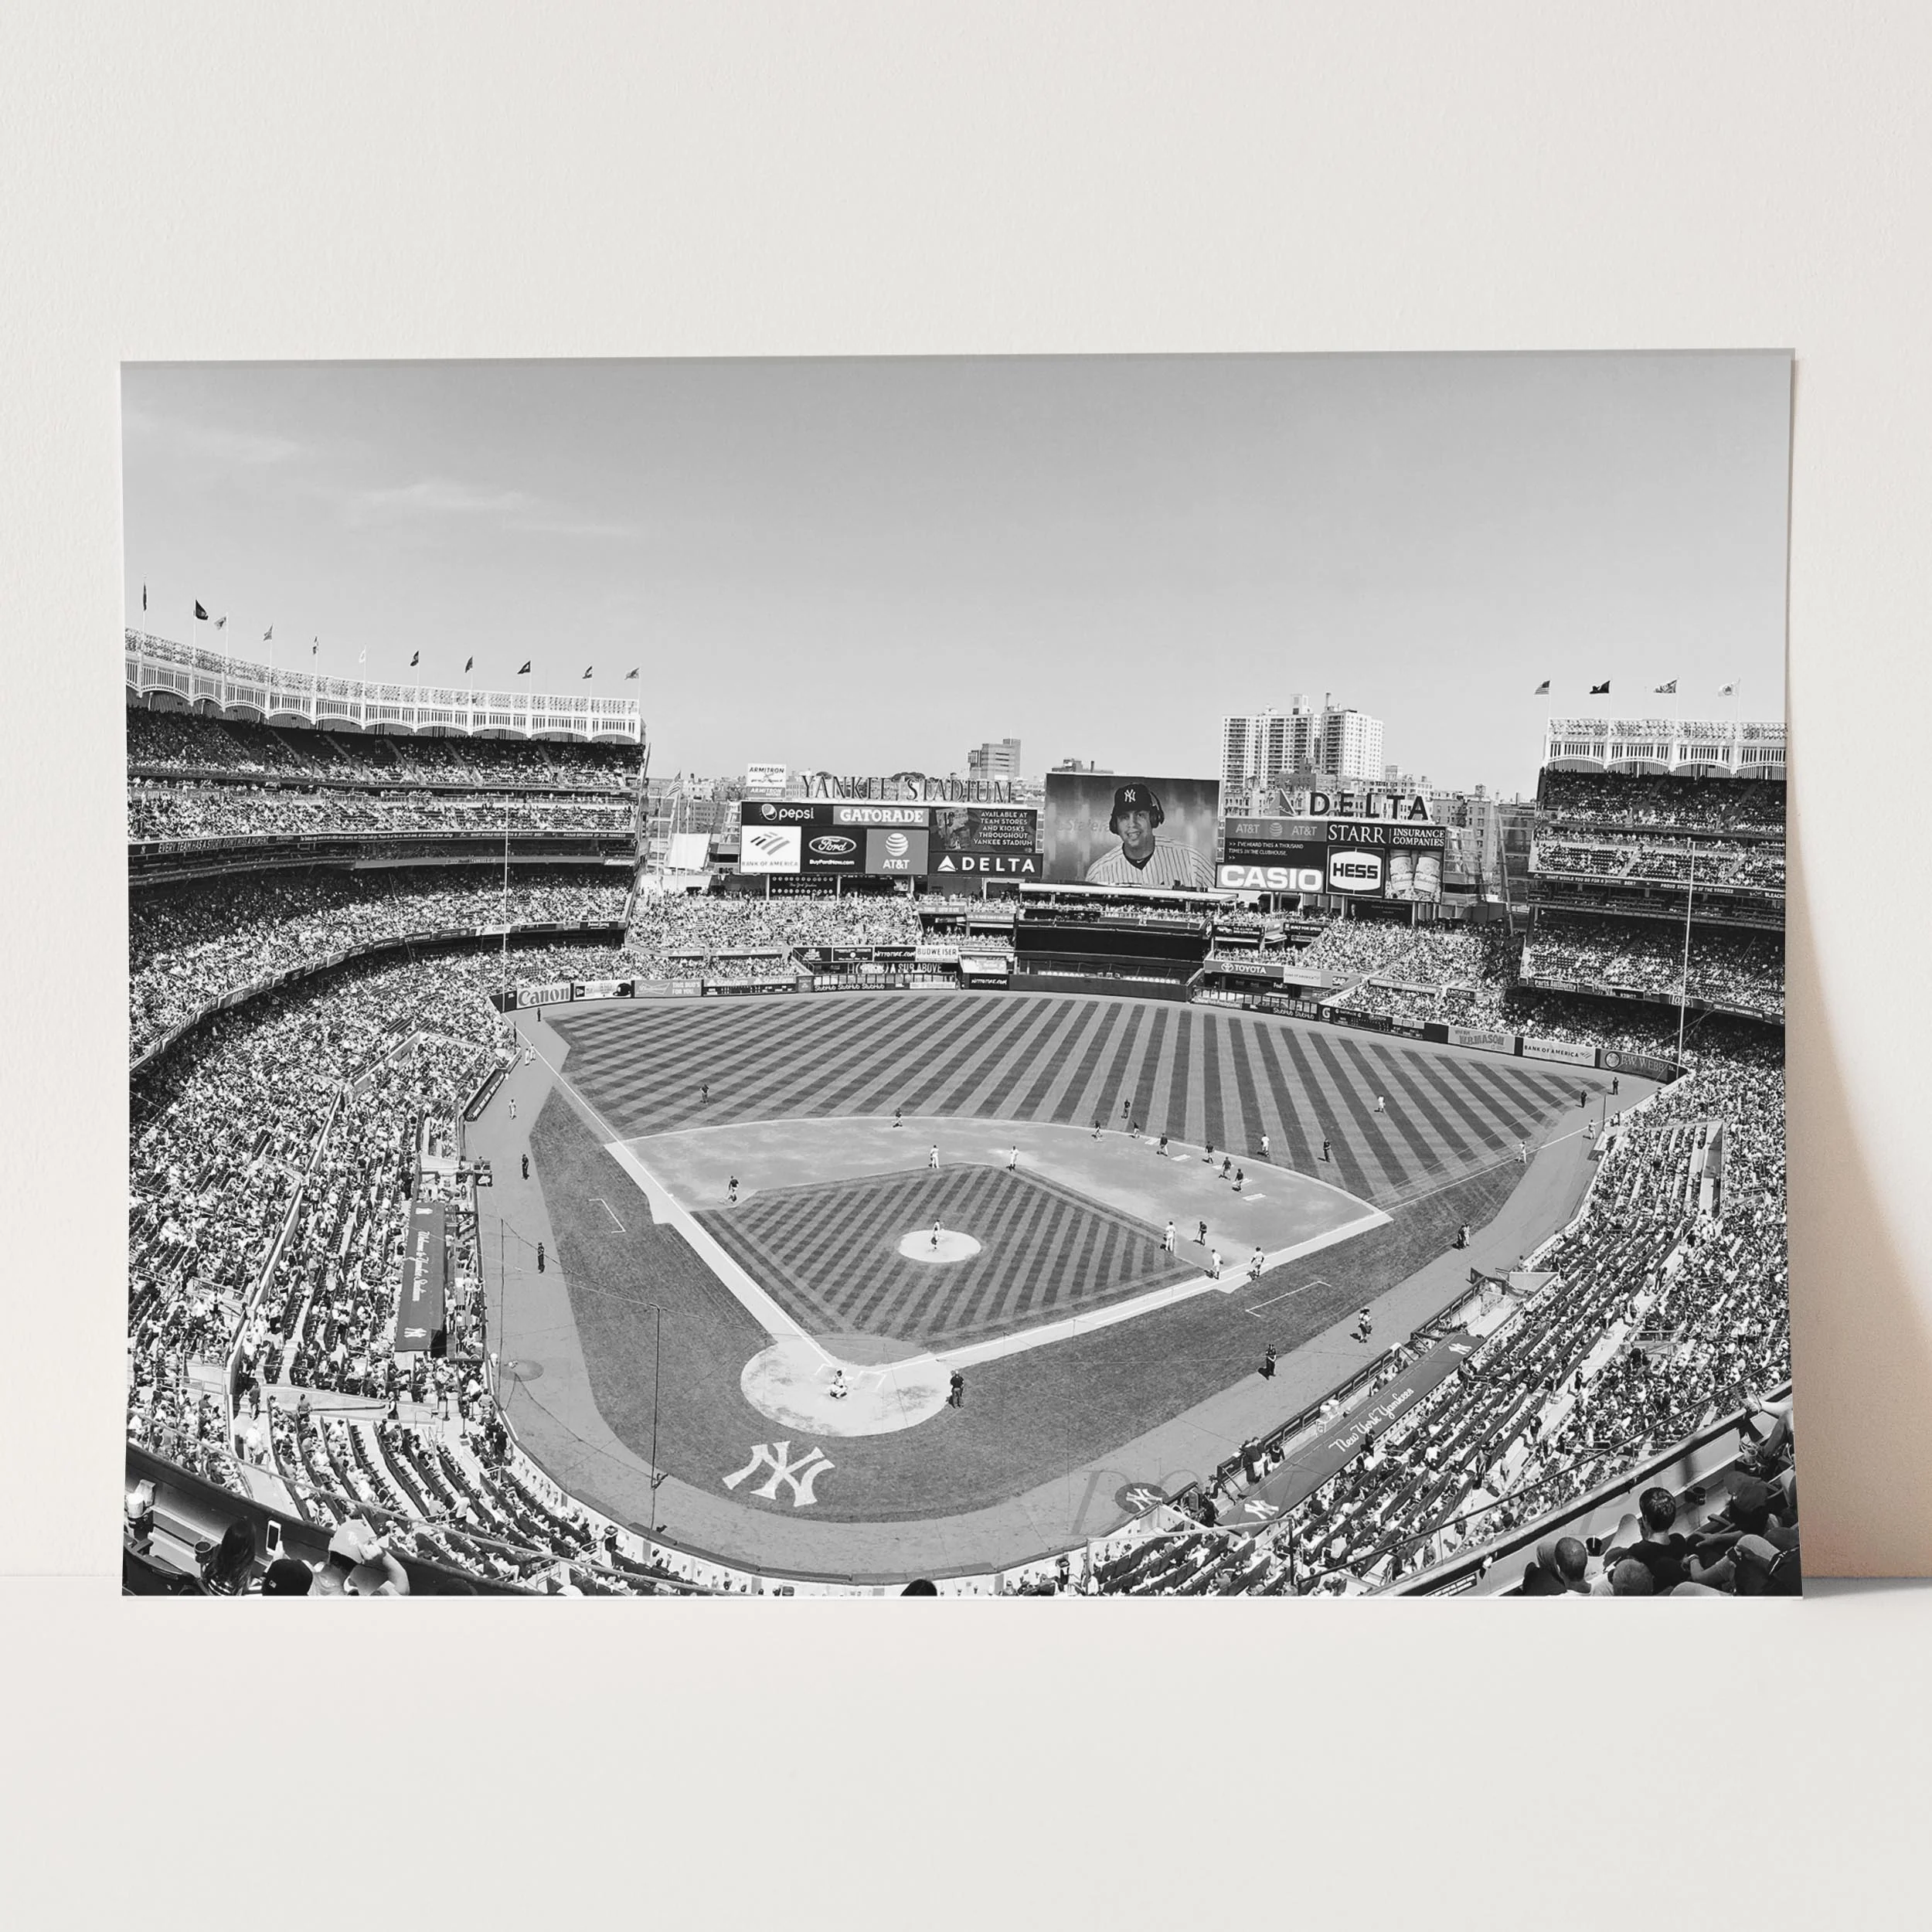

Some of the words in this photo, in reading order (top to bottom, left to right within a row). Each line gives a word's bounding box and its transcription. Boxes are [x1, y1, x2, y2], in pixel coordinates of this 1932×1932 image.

[801, 775, 892, 801] YANKEE
[906, 777, 1014, 804] STADIUM
[1124, 788, 1136, 803] NY
[1309, 791, 1429, 821] DELTA
[779, 807, 815, 821] pepsi
[840, 808, 923, 823] GATORADE
[1236, 824, 1260, 834] AT&T
[1291, 825, 1318, 835] AT&T
[1328, 824, 1386, 844] STARR
[1393, 828, 1445, 838] INSURANCE
[818, 838, 848, 852] Ford
[1393, 836, 1445, 847] COMPANIES
[883, 859, 910, 870] AT&T
[961, 856, 1036, 872] DELTA
[1333, 862, 1378, 879] HESS
[1221, 865, 1322, 891] CASIO
[917, 947, 957, 956] BUDWEISER
[916, 963, 942, 974] ABOVE
[1235, 964, 1267, 975] TOYOTA
[518, 988, 570, 1007] Canon
[1322, 1007, 1331, 1019] G
[1551, 1049, 1579, 1057] AMERICA
[1328, 1432, 1360, 1453] New
[1349, 1413, 1382, 1434] York
[1377, 1387, 1415, 1420] Yankees
[722, 1440, 835, 1507] NY
[1243, 1498, 1279, 1521] NY
